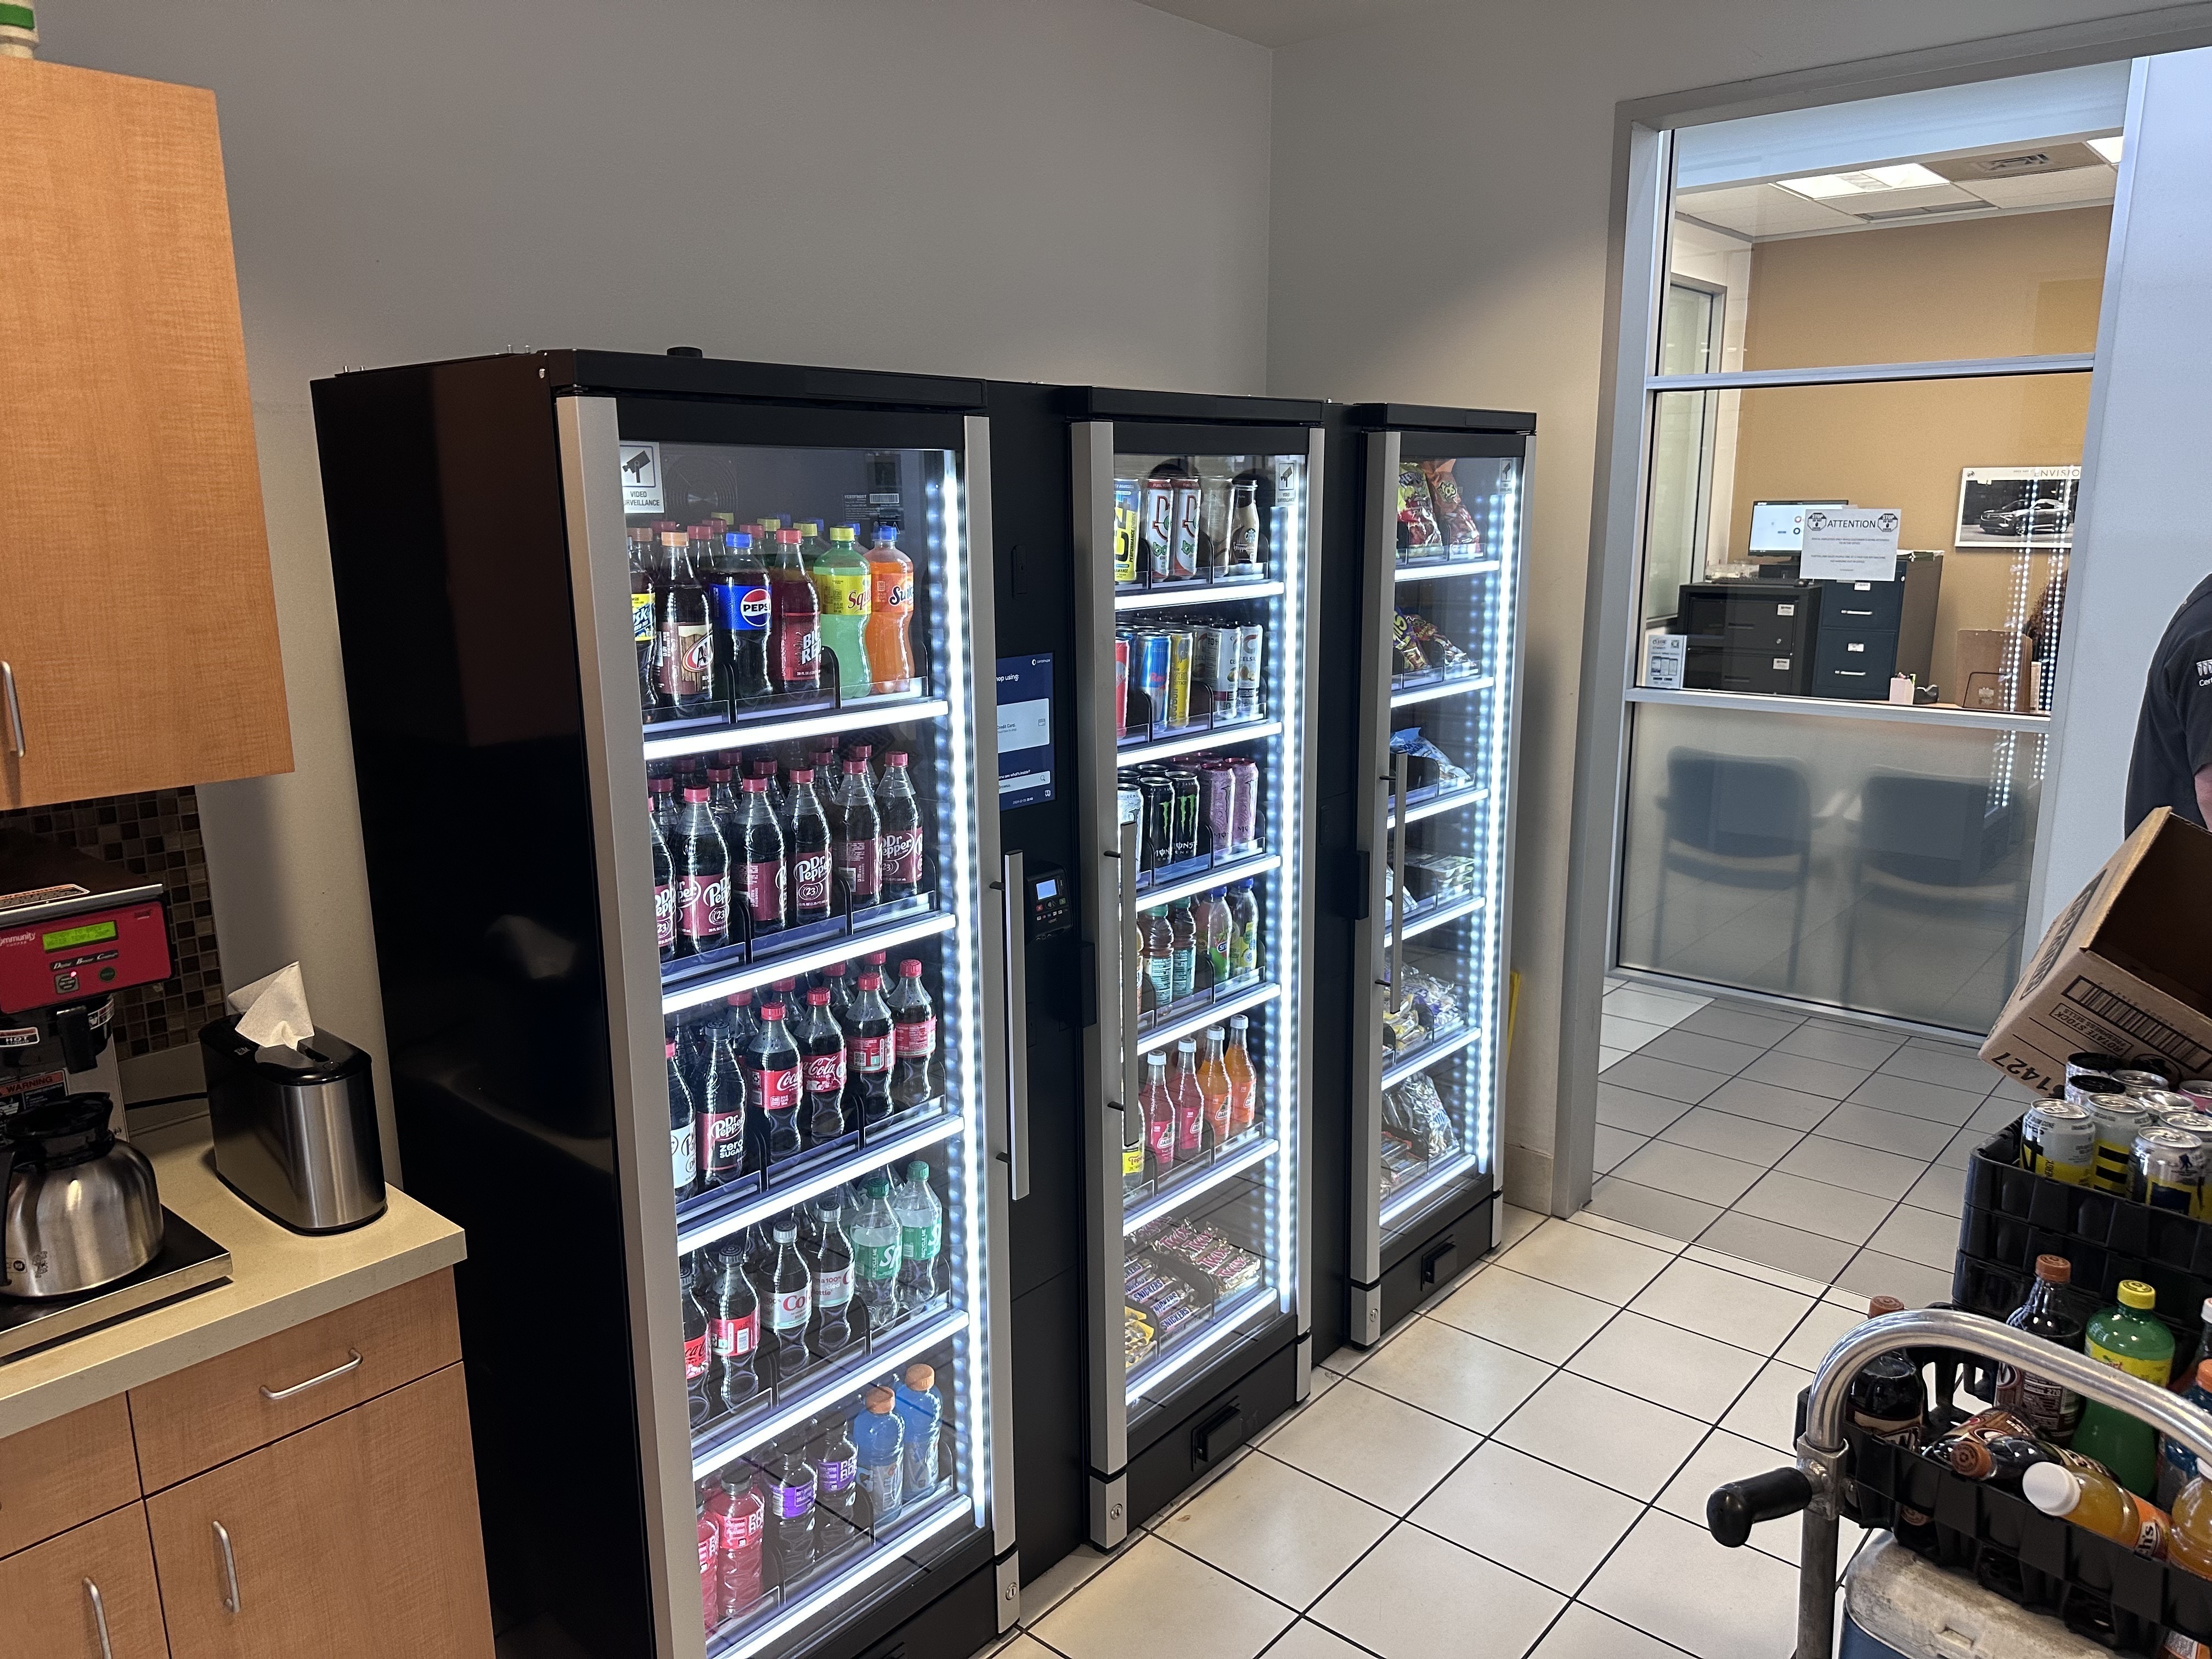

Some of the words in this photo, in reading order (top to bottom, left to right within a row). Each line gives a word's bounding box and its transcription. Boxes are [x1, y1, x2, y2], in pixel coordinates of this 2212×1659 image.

[802, 637, 821, 665] RED
[886, 835, 902, 848] Dr
[810, 856, 825, 871] Dr
[805, 887, 816, 896] 23
[0, 931, 36, 946] ommunity
[2055, 1010, 2087, 1032] STOCK
[2087, 1029, 2123, 1053] ROTATE
[6, 1075, 53, 1093] WARNING
[725, 1114, 738, 1127] Dr
[719, 1139, 743, 1153] zero
[719, 1146, 743, 1159] SUGAR
[1158, 1224, 1192, 1252] TWIX
[1196, 1246, 1231, 1272] TWIX
[1215, 1256, 1250, 1278] TWIX
[1125, 1263, 1143, 1280] CKERS
[1133, 1279, 1164, 1302] SNICKERS
[783, 1295, 806, 1311] Co
[1153, 1292, 1179, 1316] NICKERS
[1160, 1307, 1191, 1331] SNICKERS
